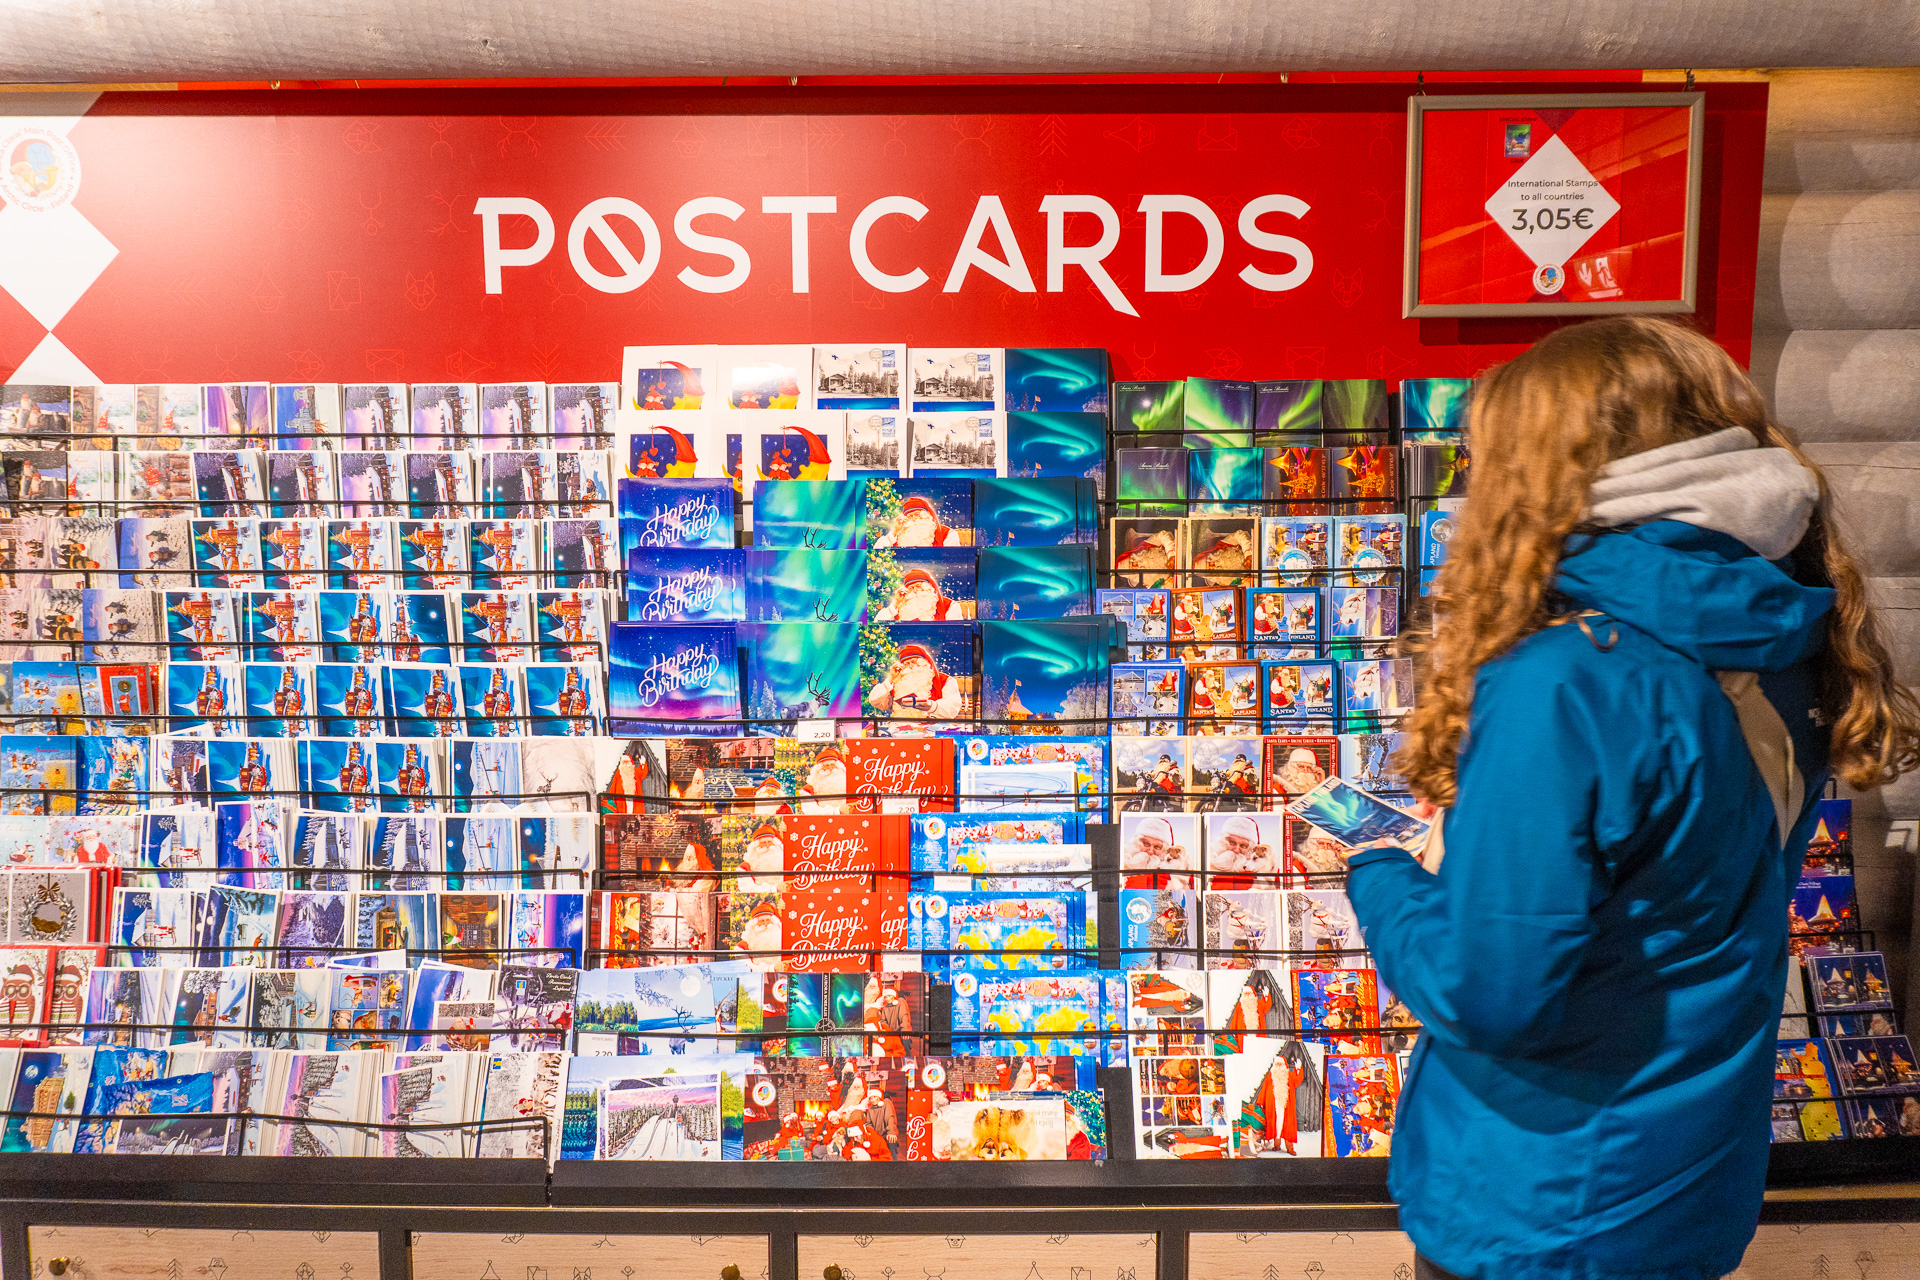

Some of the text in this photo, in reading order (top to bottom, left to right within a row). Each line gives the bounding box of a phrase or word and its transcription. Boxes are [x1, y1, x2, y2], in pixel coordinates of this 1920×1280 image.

[23, 127, 45, 135] Main
[1508, 179, 1599, 188] International Stamps
[1521, 192, 1585, 201] to all countries
[1511, 207, 1594, 235] 3,05€
[473, 194, 1314, 318] POSTCARDS
[640, 505, 719, 547] Birthday
[647, 495, 708, 530] Happy
[642, 576, 723, 621] Birthday
[649, 566, 712, 602] Happy
[644, 643, 707, 679] Happy
[639, 654, 720, 707] Birthday
[1307, 706, 1333, 714] FINLAND
[864, 755, 926, 783] Happy
[801, 832, 863, 861] Happy
[792, 861, 875, 890] Birthday
[800, 910, 863, 939] Happy
[790, 937, 874, 970] Birthday
